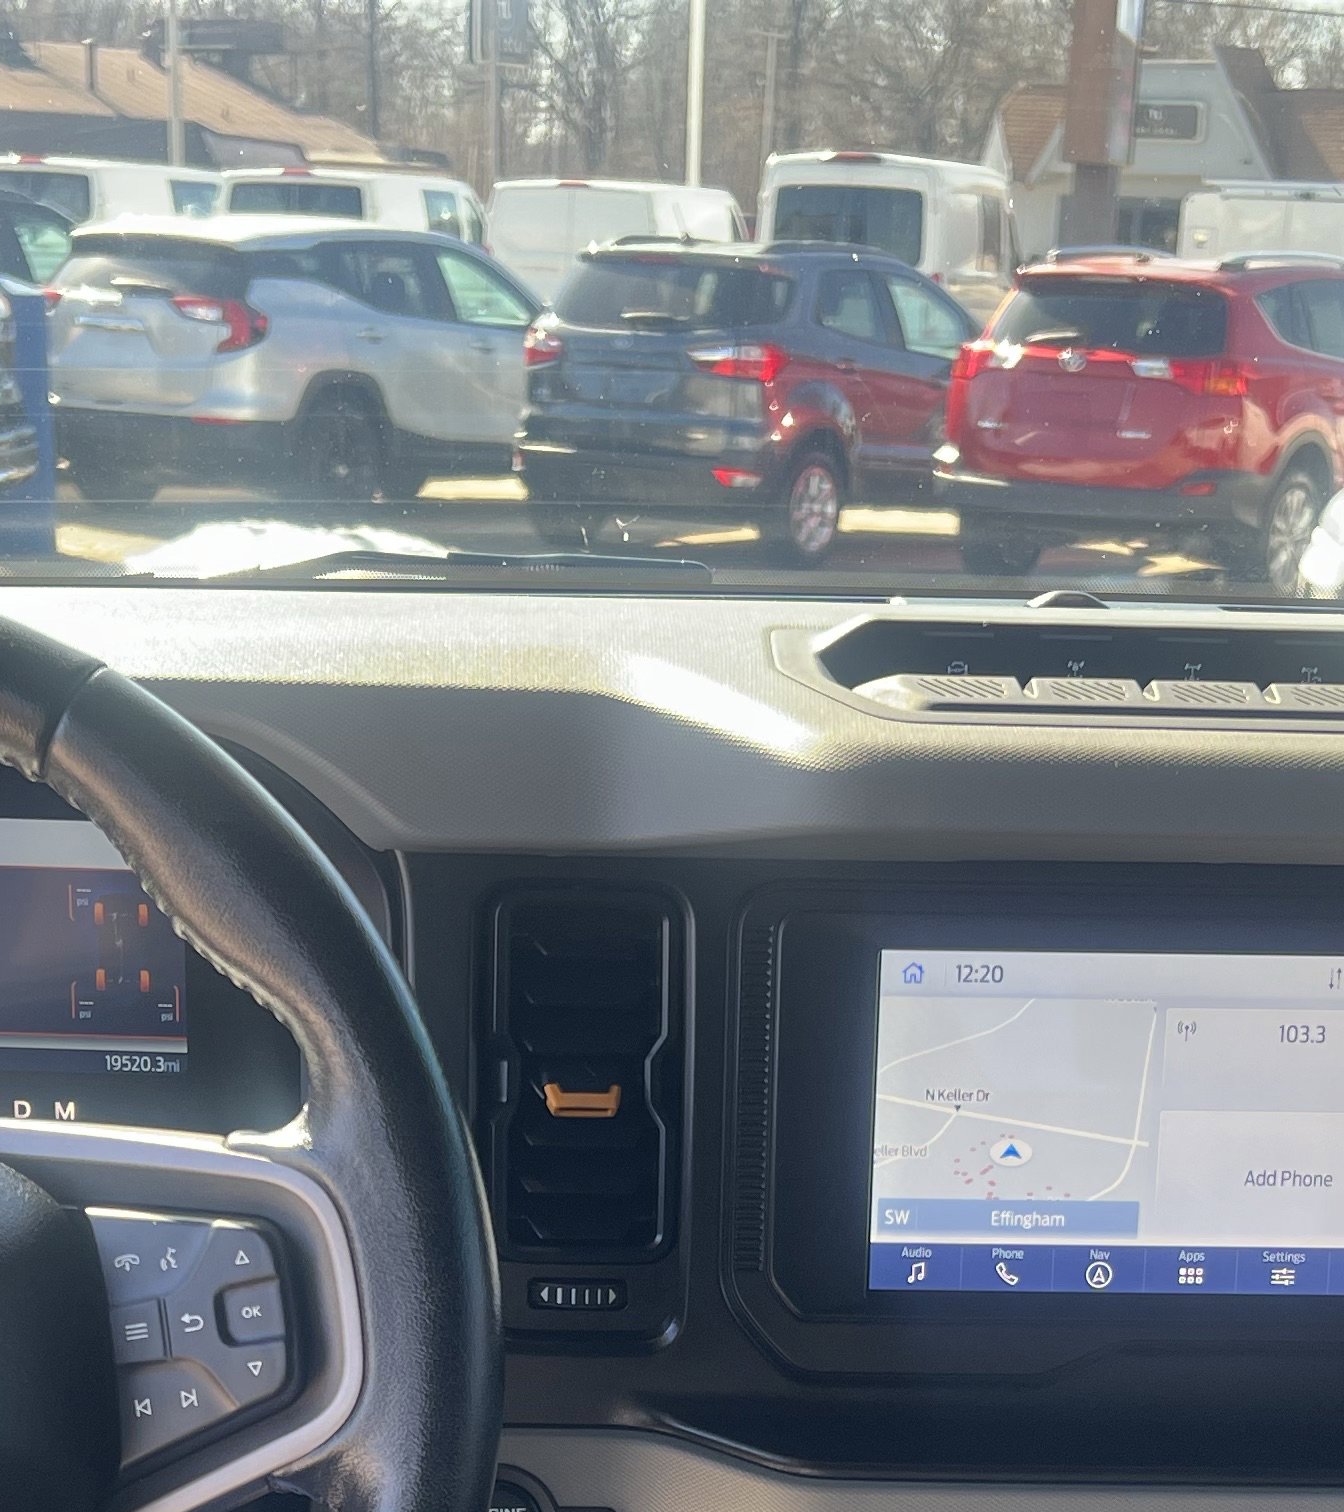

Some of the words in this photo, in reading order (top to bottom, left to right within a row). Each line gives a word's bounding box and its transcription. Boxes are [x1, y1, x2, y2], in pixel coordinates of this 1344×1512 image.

[955, 964, 1004, 984] 12:20
[1279, 1024, 1326, 1044] 103.3
[925, 1090, 935, 1102] N
[937, 1089, 974, 1102] Keller
[976, 1089, 990, 1102] Dr
[14, 1100, 32, 1118] D
[54, 1101, 76, 1120] M
[874, 1144, 899, 1158] eller
[901, 1144, 928, 1158] Blvd
[1244, 1170, 1277, 1187] Add
[1280, 1170, 1333, 1188] Phone
[884, 1210, 910, 1225] SW
[991, 1210, 1065, 1229] Effingham
[901, 1246, 932, 1259] Audio
[991, 1247, 1024, 1260] Phone
[1089, 1249, 1110, 1261] Nav
[1178, 1250, 1206, 1263] Apps
[1262, 1250, 1306, 1265] Settings
[241, 1305, 263, 1318] OK
